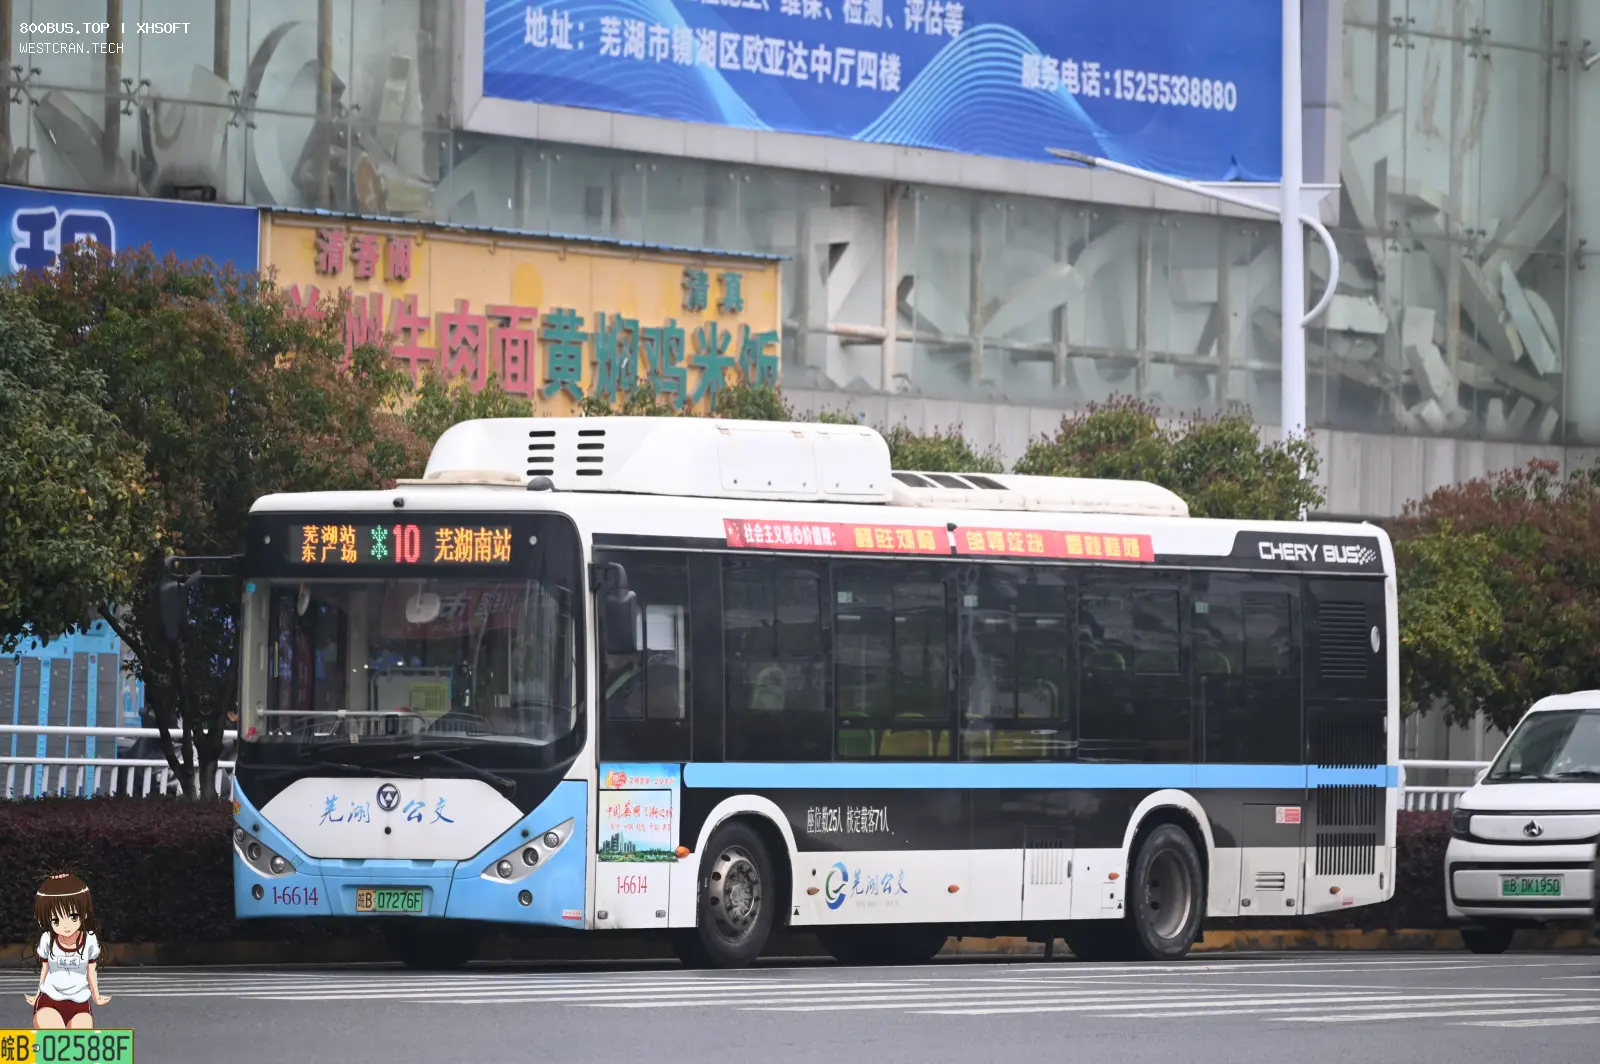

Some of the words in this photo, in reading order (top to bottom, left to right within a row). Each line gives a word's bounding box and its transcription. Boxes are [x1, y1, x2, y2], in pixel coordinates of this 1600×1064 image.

[682, 269, 744, 312] 清真
[302, 525, 357, 544] 芜湖站
[392, 524, 421, 563] 10
[434, 527, 512, 562] 芜湖南站
[301, 544, 358, 563] 东广场
[1258, 541, 1318, 562] CHERY
[1322, 545, 1359, 564] BUS
[616, 876, 647, 894] 1-6614
[272, 886, 319, 906] 1-6614
[377, 892, 422, 909] 07276F
